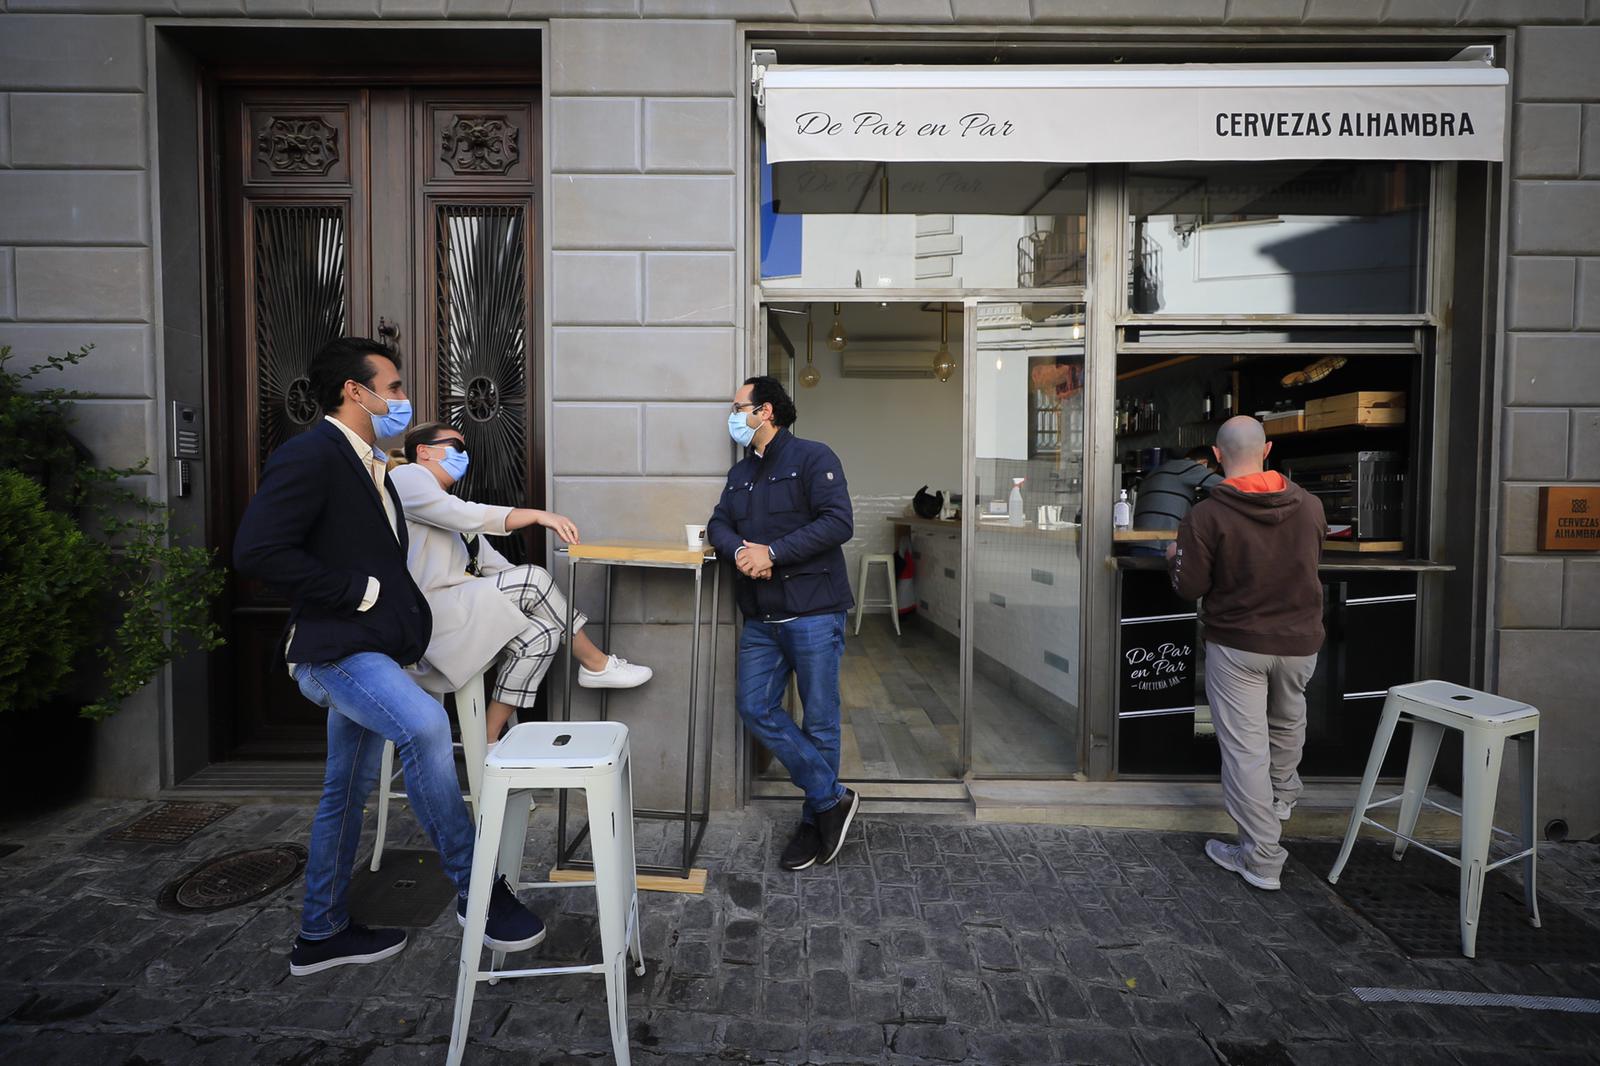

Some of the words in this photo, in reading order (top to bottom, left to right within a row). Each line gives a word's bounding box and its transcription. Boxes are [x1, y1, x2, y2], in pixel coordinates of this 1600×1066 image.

[795, 111, 843, 136] De
[852, 111, 908, 137] Par
[917, 122, 951, 136] en
[958, 112, 1016, 138] Par
[1215, 112, 1332, 137] CERVEZAS
[1338, 112, 1475, 137] ALHAMBRA
[1558, 517, 1600, 527] CERVEZAS
[1125, 647, 1155, 665] De
[1157, 642, 1192, 659] Par
[1131, 668, 1150, 679] en
[1152, 659, 1186, 675] Par
